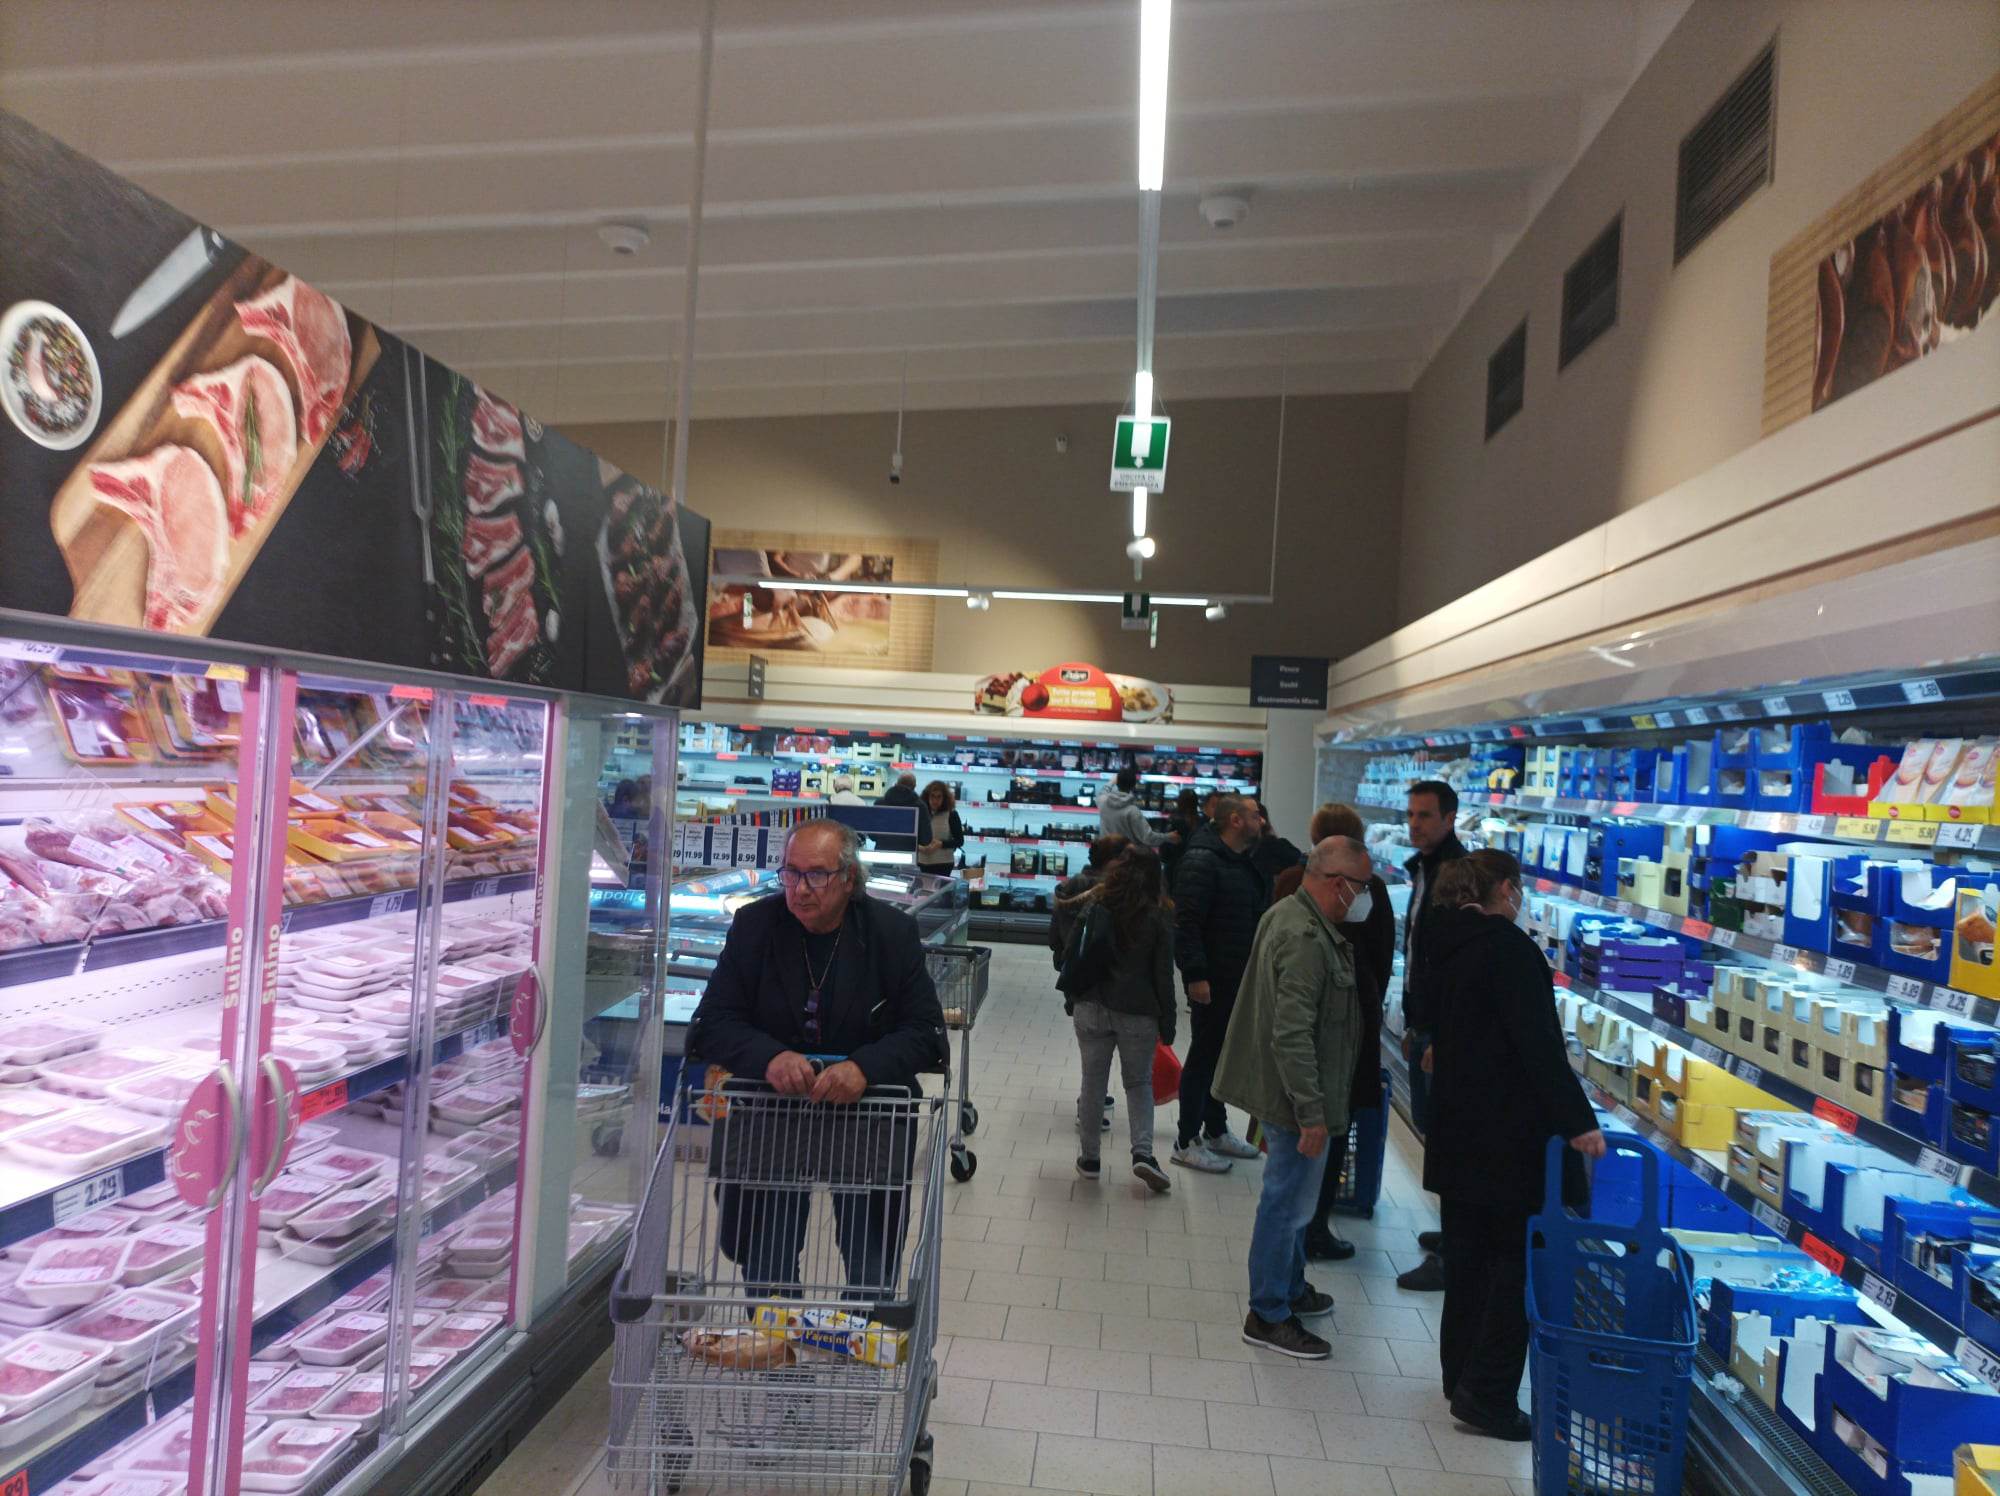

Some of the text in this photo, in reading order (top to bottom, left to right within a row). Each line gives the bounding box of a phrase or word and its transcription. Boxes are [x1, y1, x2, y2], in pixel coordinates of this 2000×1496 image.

[684, 849, 703, 858] 11.99
[737, 853, 756, 862] 8.99
[224, 926, 243, 1009] suino
[262, 924, 280, 1005] suino
[1875, 1285, 1895, 1307] 2.15
